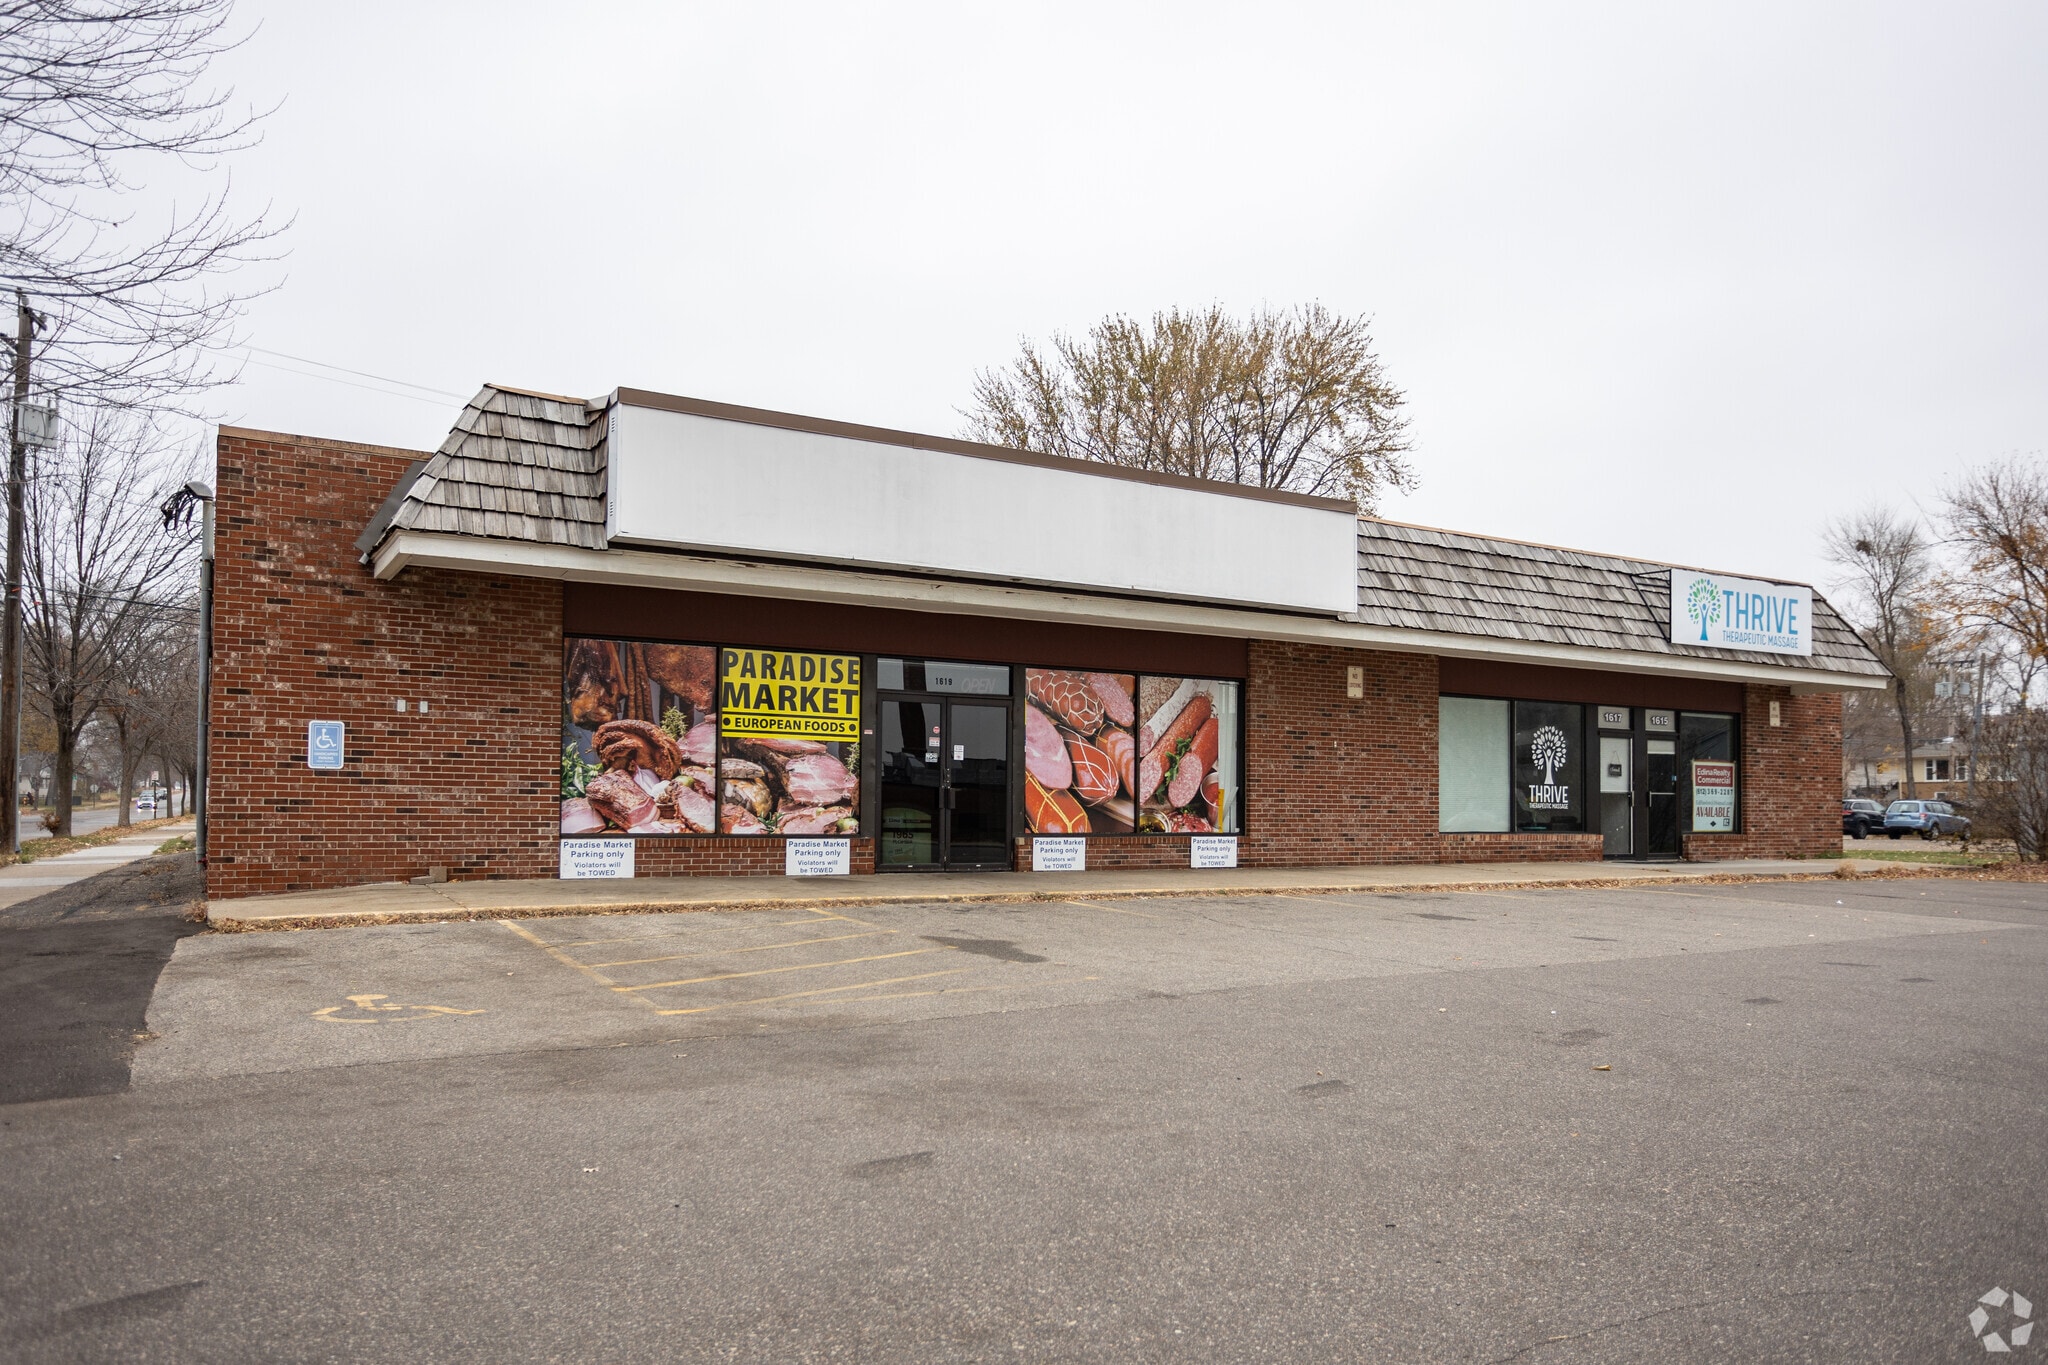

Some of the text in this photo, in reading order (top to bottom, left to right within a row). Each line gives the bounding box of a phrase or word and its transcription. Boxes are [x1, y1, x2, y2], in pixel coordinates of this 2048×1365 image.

[1722, 590, 1798, 635] THRIVE
[1722, 630, 1798, 649] THERAPEUTIC MASSAGE
[722, 650, 859, 685] PARADISE
[935, 677, 953, 686] 1619
[722, 682, 859, 714] MARKET
[1604, 712, 1622, 722] 1617
[1651, 716, 1669, 725] 1615
[734, 718, 846, 732] EUROPEAN FOODS
[1697, 776, 1731, 784] Commercial
[1529, 785, 1568, 803] THRIVE
[1696, 806, 1731, 817] AVAILABLE
[571, 851, 603, 859] Parking
